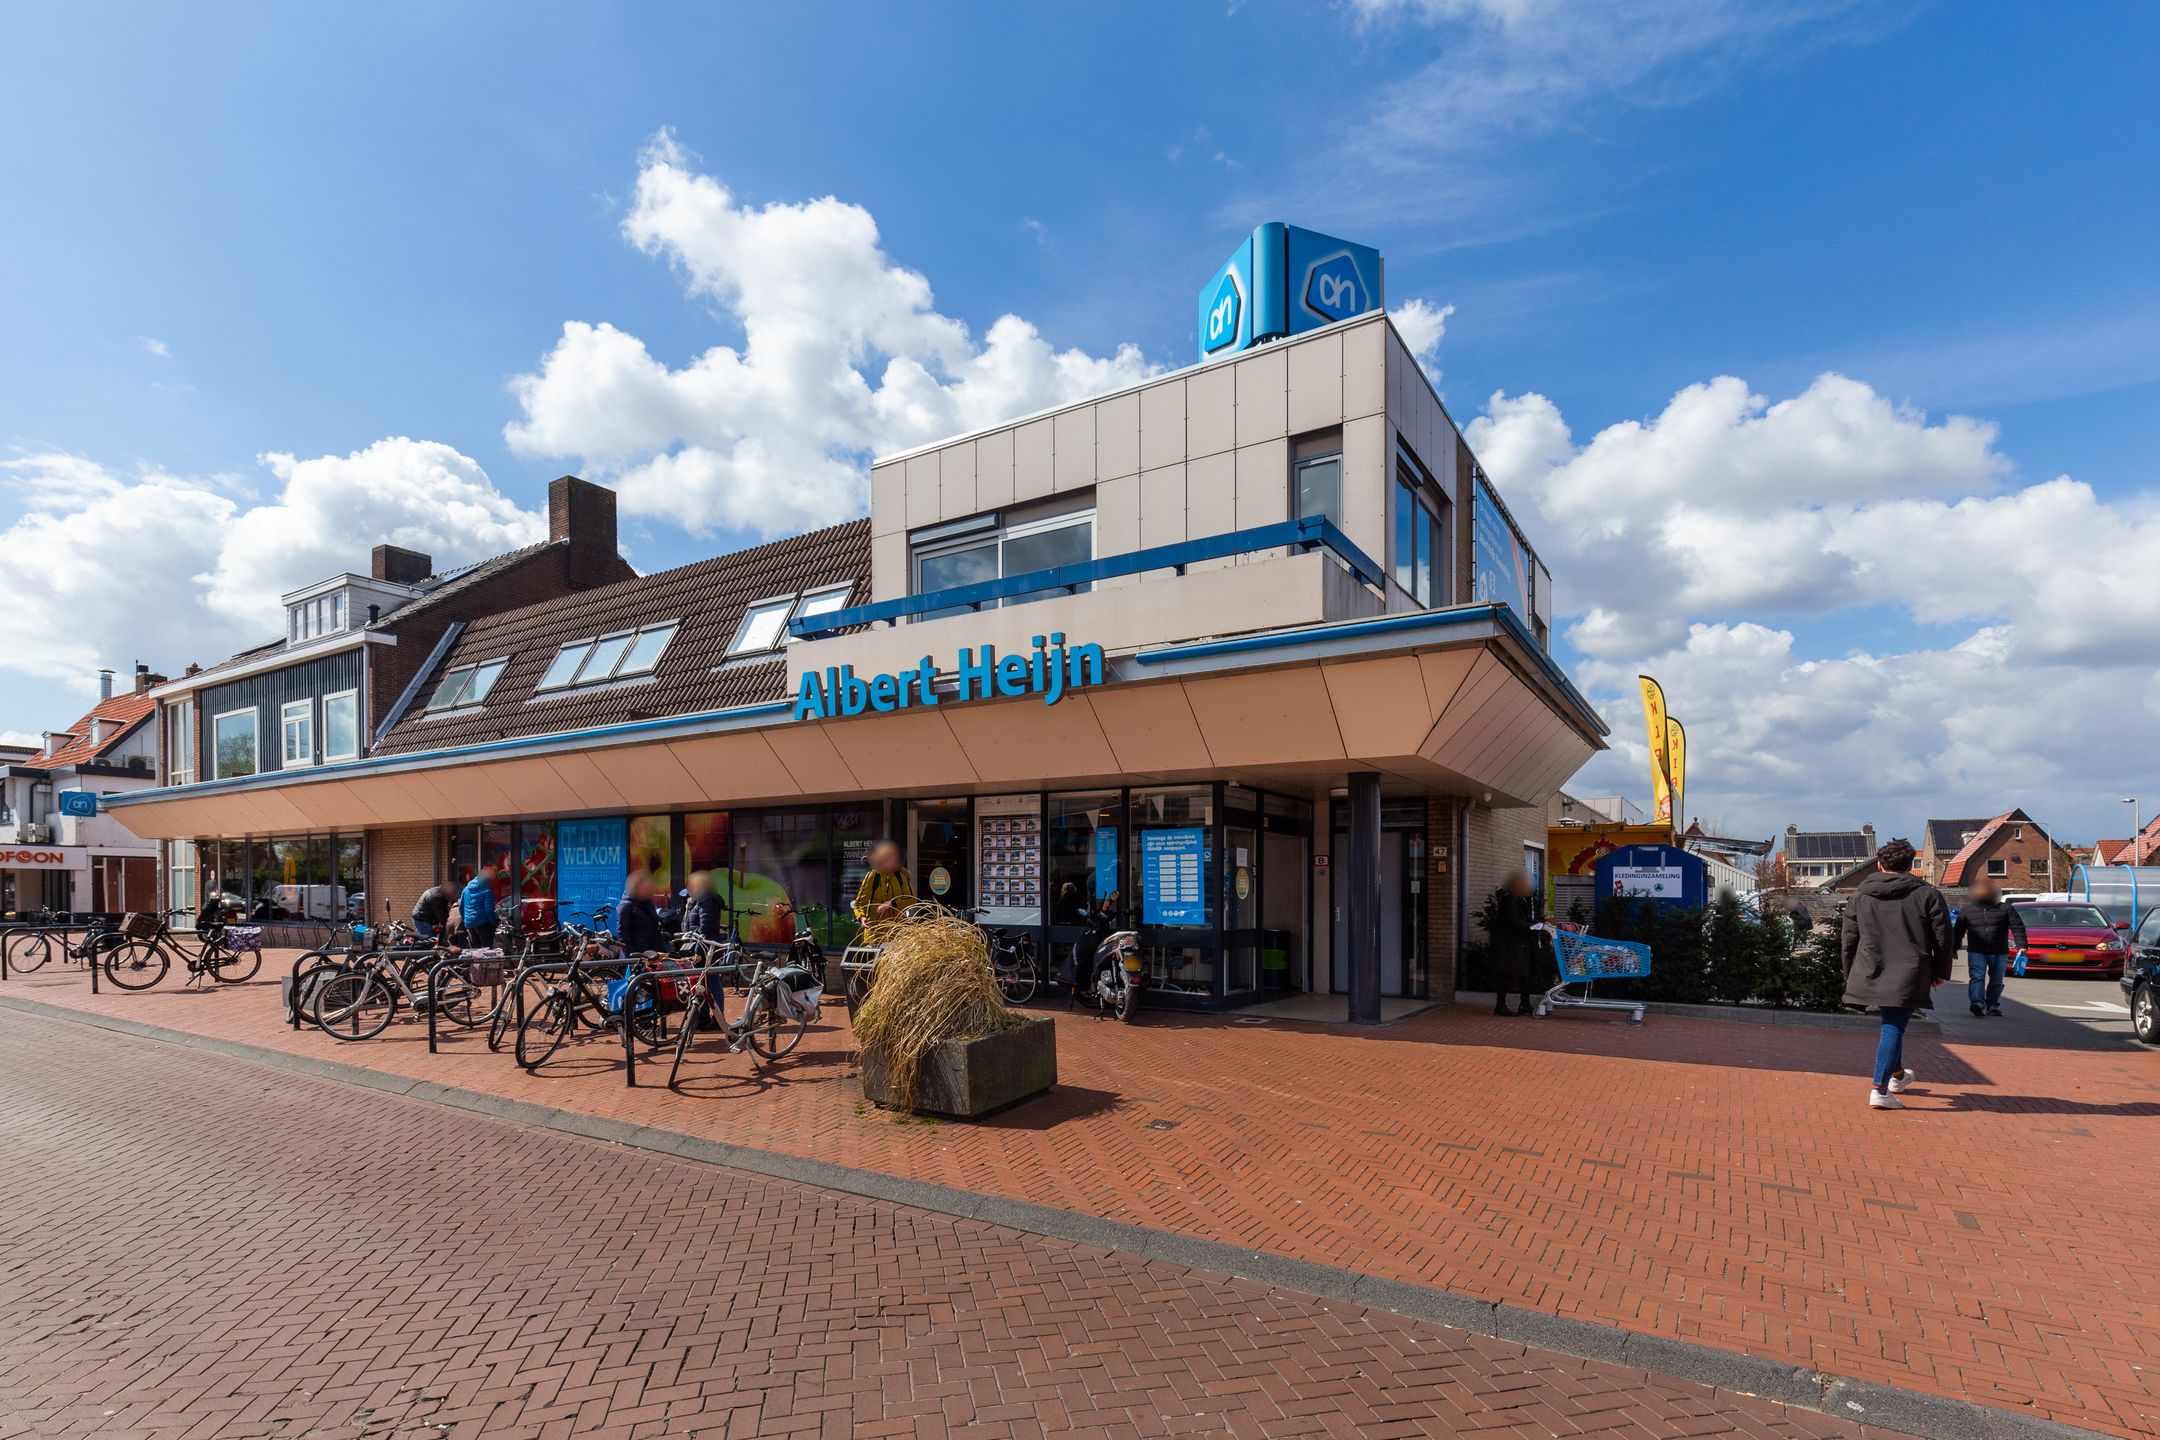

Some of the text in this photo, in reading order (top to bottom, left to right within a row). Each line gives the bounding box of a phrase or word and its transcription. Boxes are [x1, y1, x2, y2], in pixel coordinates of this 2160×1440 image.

[794, 631, 1107, 721] Albert Heijn
[563, 846, 620, 865] WELKOM
[1435, 848, 1446, 856] 47
